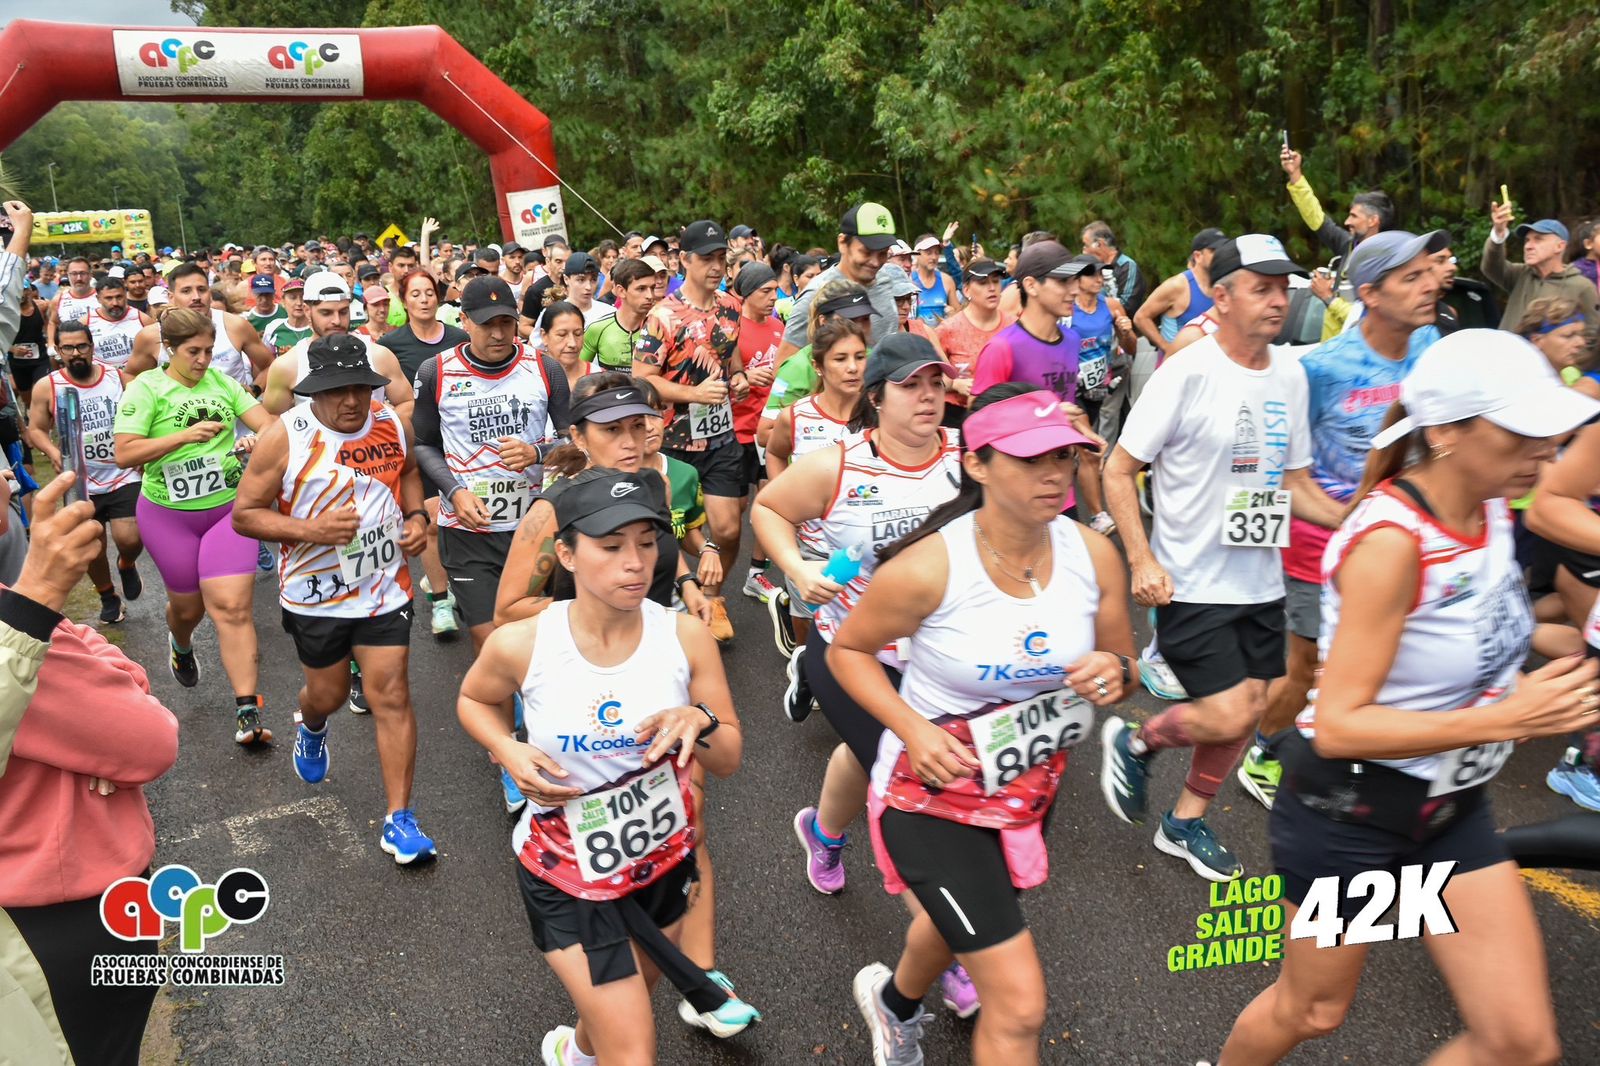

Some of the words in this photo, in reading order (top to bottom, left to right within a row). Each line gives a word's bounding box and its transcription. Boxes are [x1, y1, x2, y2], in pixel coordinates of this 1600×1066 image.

[63, 222, 83, 233] 42K
[99, 338, 118, 347] LAGO
[100, 344, 123, 353] SALTO
[102, 349, 130, 359] GRANDE
[468, 394, 508, 408] MARATON
[81, 411, 106, 423] ALTO
[210, 399, 232, 422] SALUD
[468, 404, 502, 419] LAGO
[81, 416, 115, 433] RANDE
[469, 414, 510, 431] SALTO
[696, 411, 731, 436] 484
[94, 430, 111, 443] 10K
[471, 423, 522, 443] GRANDE
[340, 442, 401, 466] POWER
[183, 456, 206, 473] 10K
[354, 460, 399, 478] Running
[172, 470, 222, 499] 972
[490, 480, 516, 495] 10K
[1250, 490, 1276, 508] 21K
[361, 523, 386, 548] 10K
[872, 517, 921, 541] LAGO
[1228, 512, 1284, 544] 337
[347, 539, 395, 578] 710
[976, 664, 1012, 681] 7K
[1013, 664, 1067, 679] code
[1016, 694, 1062, 735] 10K
[557, 735, 591, 753] 7K
[607, 778, 650, 820] 10K
[585, 797, 677, 874] 865
